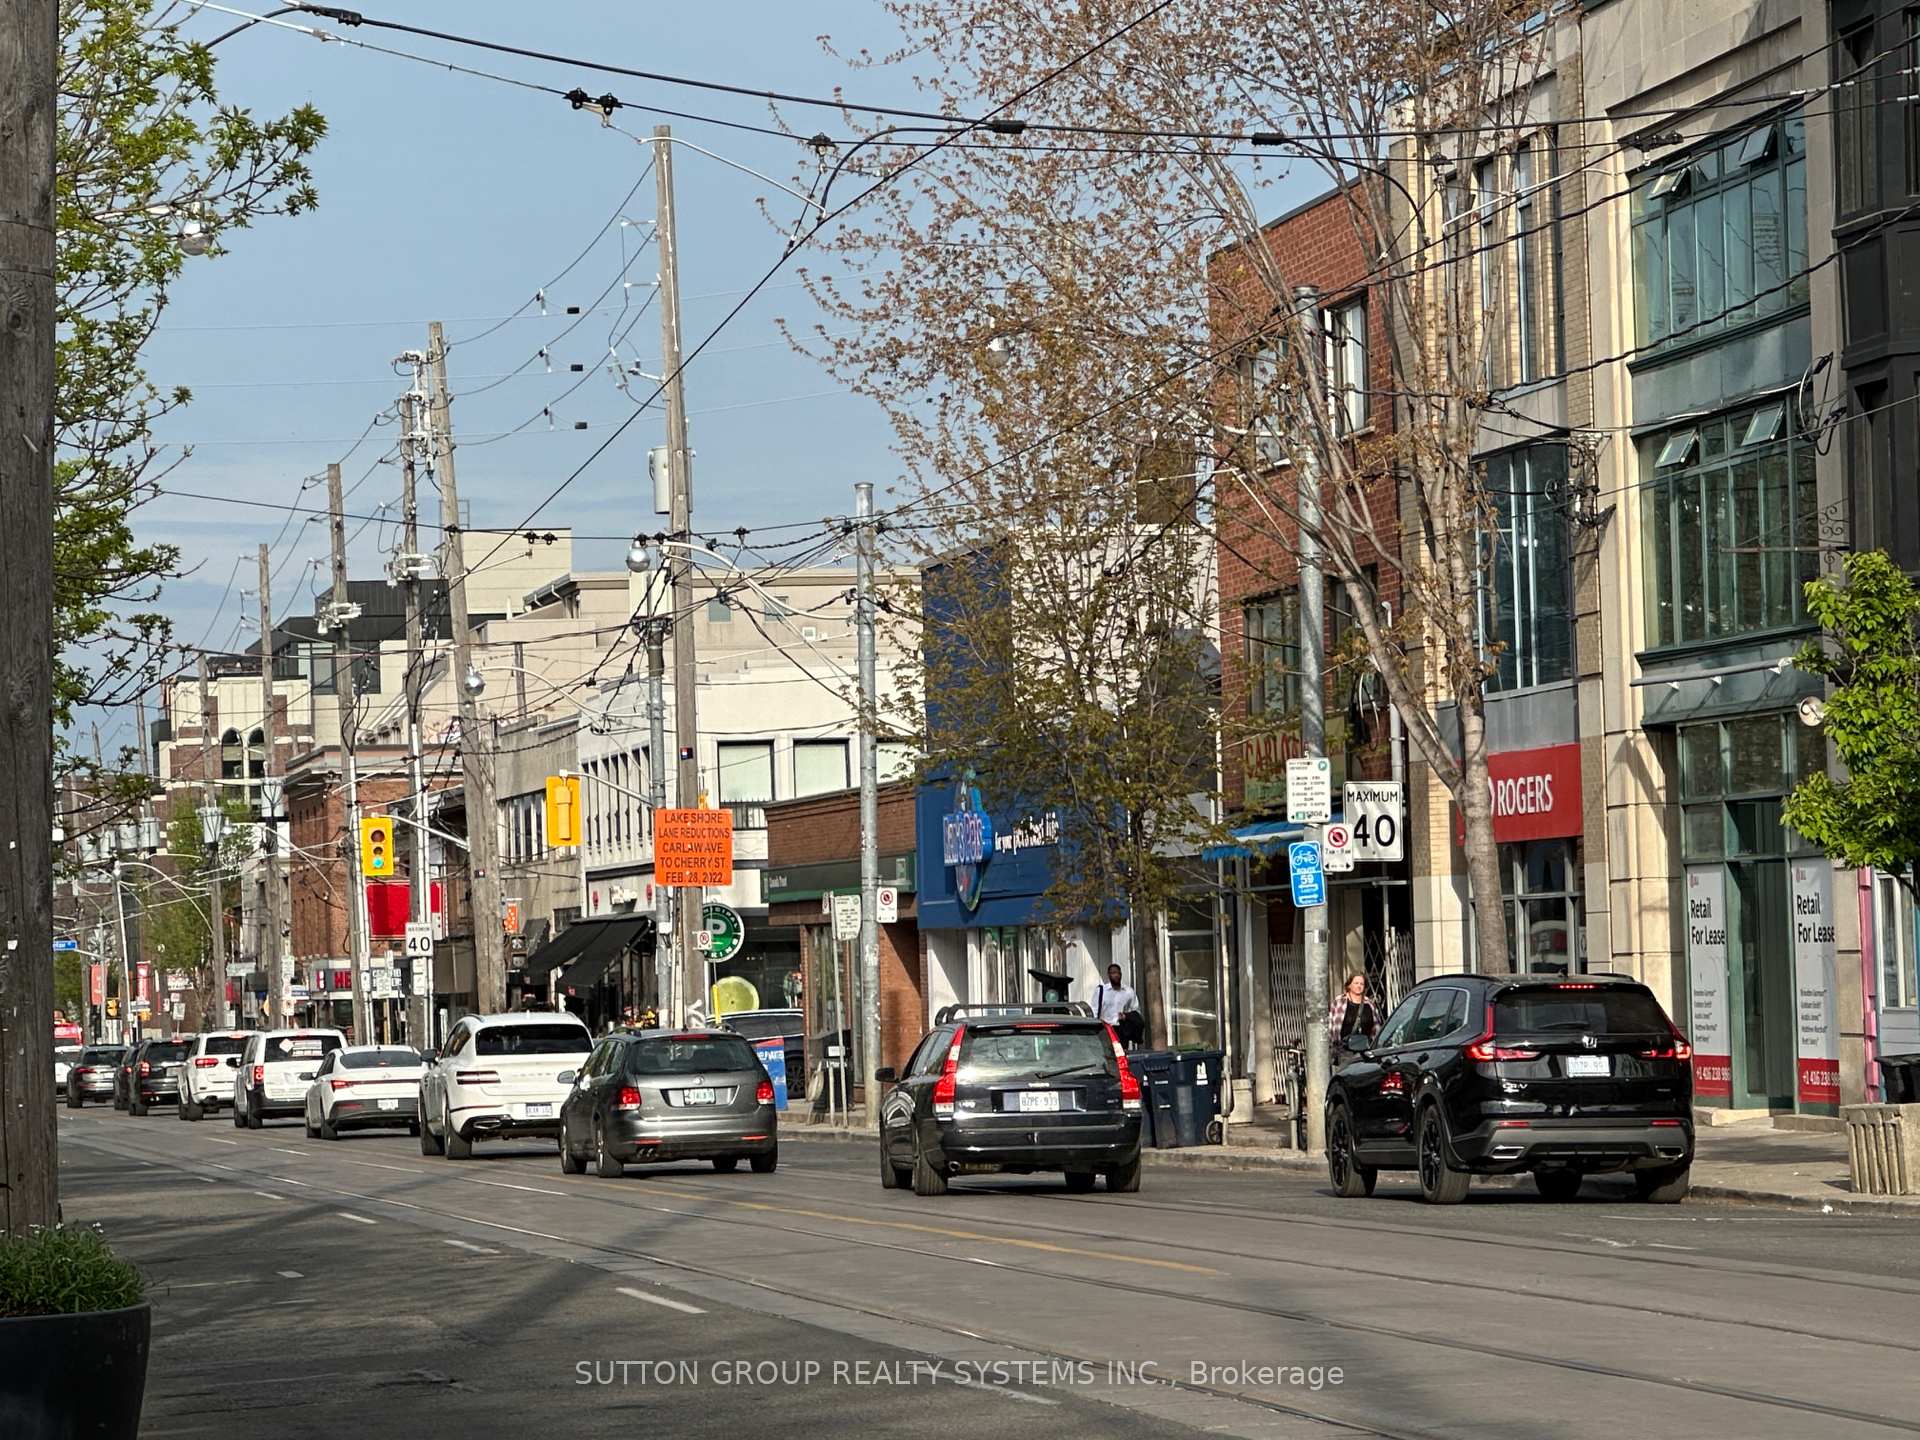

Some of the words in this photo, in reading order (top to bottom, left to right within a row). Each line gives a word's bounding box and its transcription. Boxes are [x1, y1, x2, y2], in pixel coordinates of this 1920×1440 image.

[1347, 790, 1398, 803] MAXIMUM
[1497, 773, 1554, 817] ROGERS
[658, 827, 679, 839] LANE
[680, 827, 730, 839] REDUCTIONS
[1354, 813, 1396, 848] 40
[662, 842, 703, 853] CARLAW
[660, 857, 673, 868] TO
[675, 857, 713, 869] CHERRY
[1300, 874, 1314, 885] 59
[1691, 896, 1712, 919] Retail
[1796, 892, 1821, 915] Retail
[1691, 926, 1704, 945] For
[1705, 926, 1726, 946] Lease
[1798, 923, 1811, 944] For
[1813, 923, 1836, 944] Lease
[408, 936, 431, 952] 40
